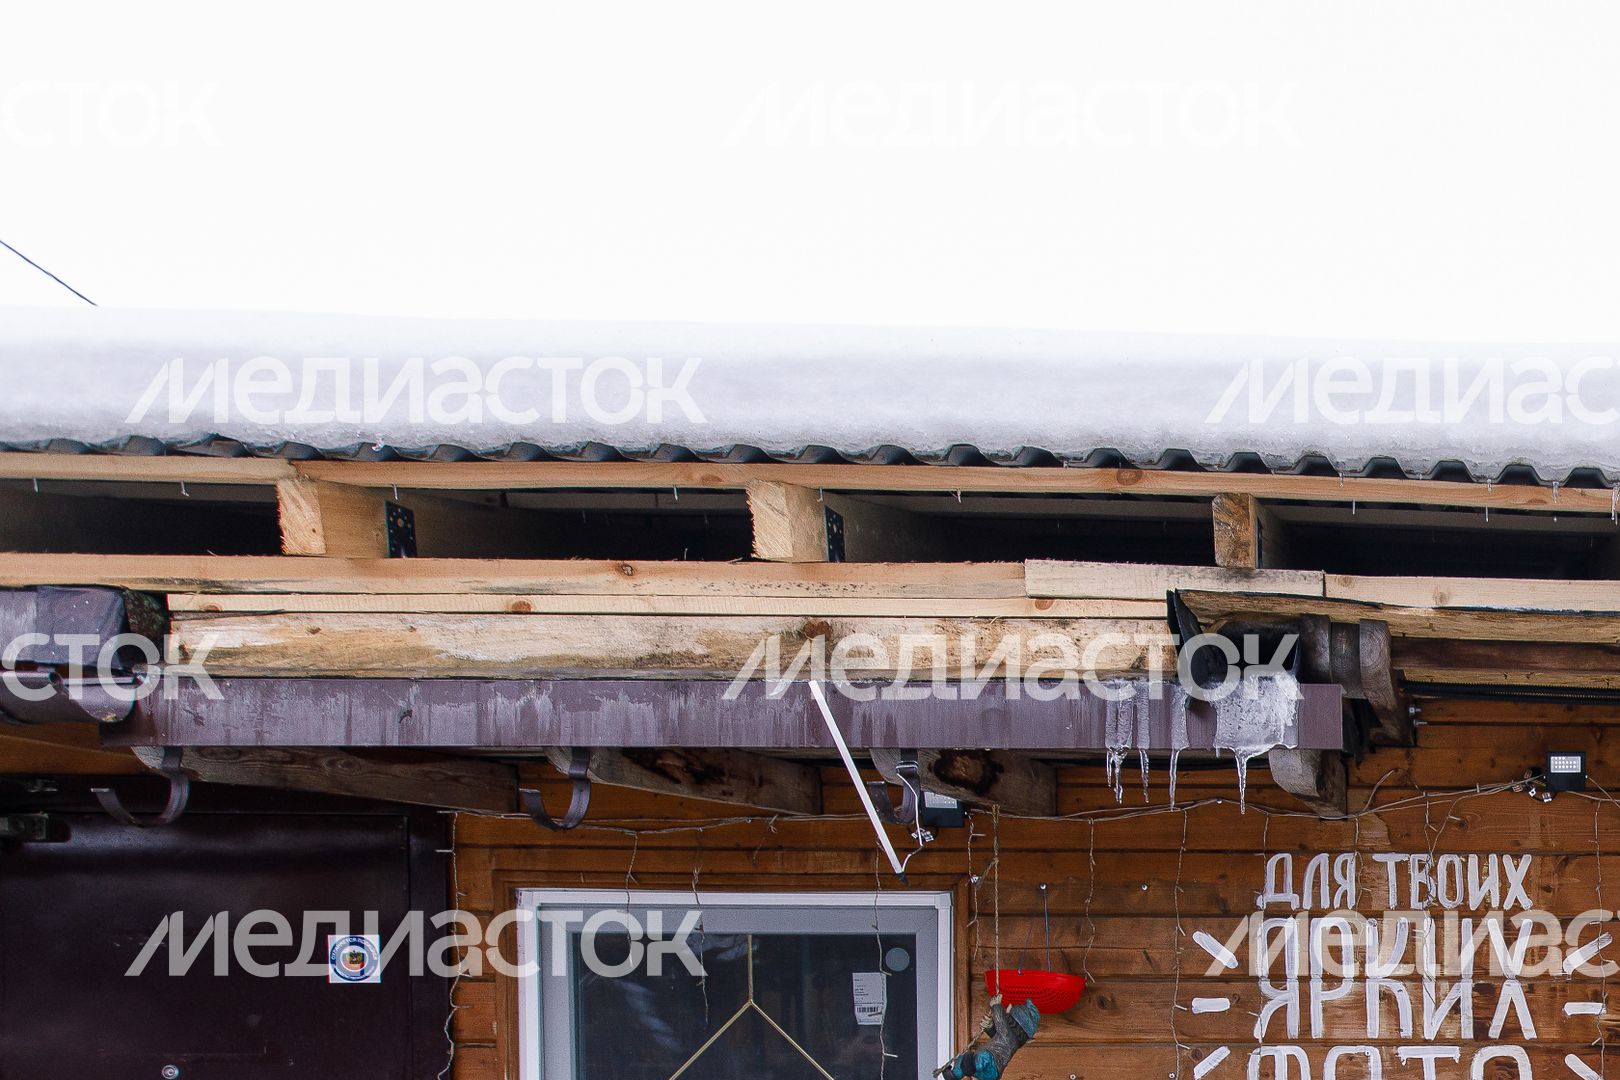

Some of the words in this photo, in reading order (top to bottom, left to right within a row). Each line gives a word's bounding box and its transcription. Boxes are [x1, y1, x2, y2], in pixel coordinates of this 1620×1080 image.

[1256, 852, 1359, 911] ДЛЯ
[1371, 852, 1534, 911] ТВОИХ
[1253, 917, 1538, 1040] ЯРКИХ
